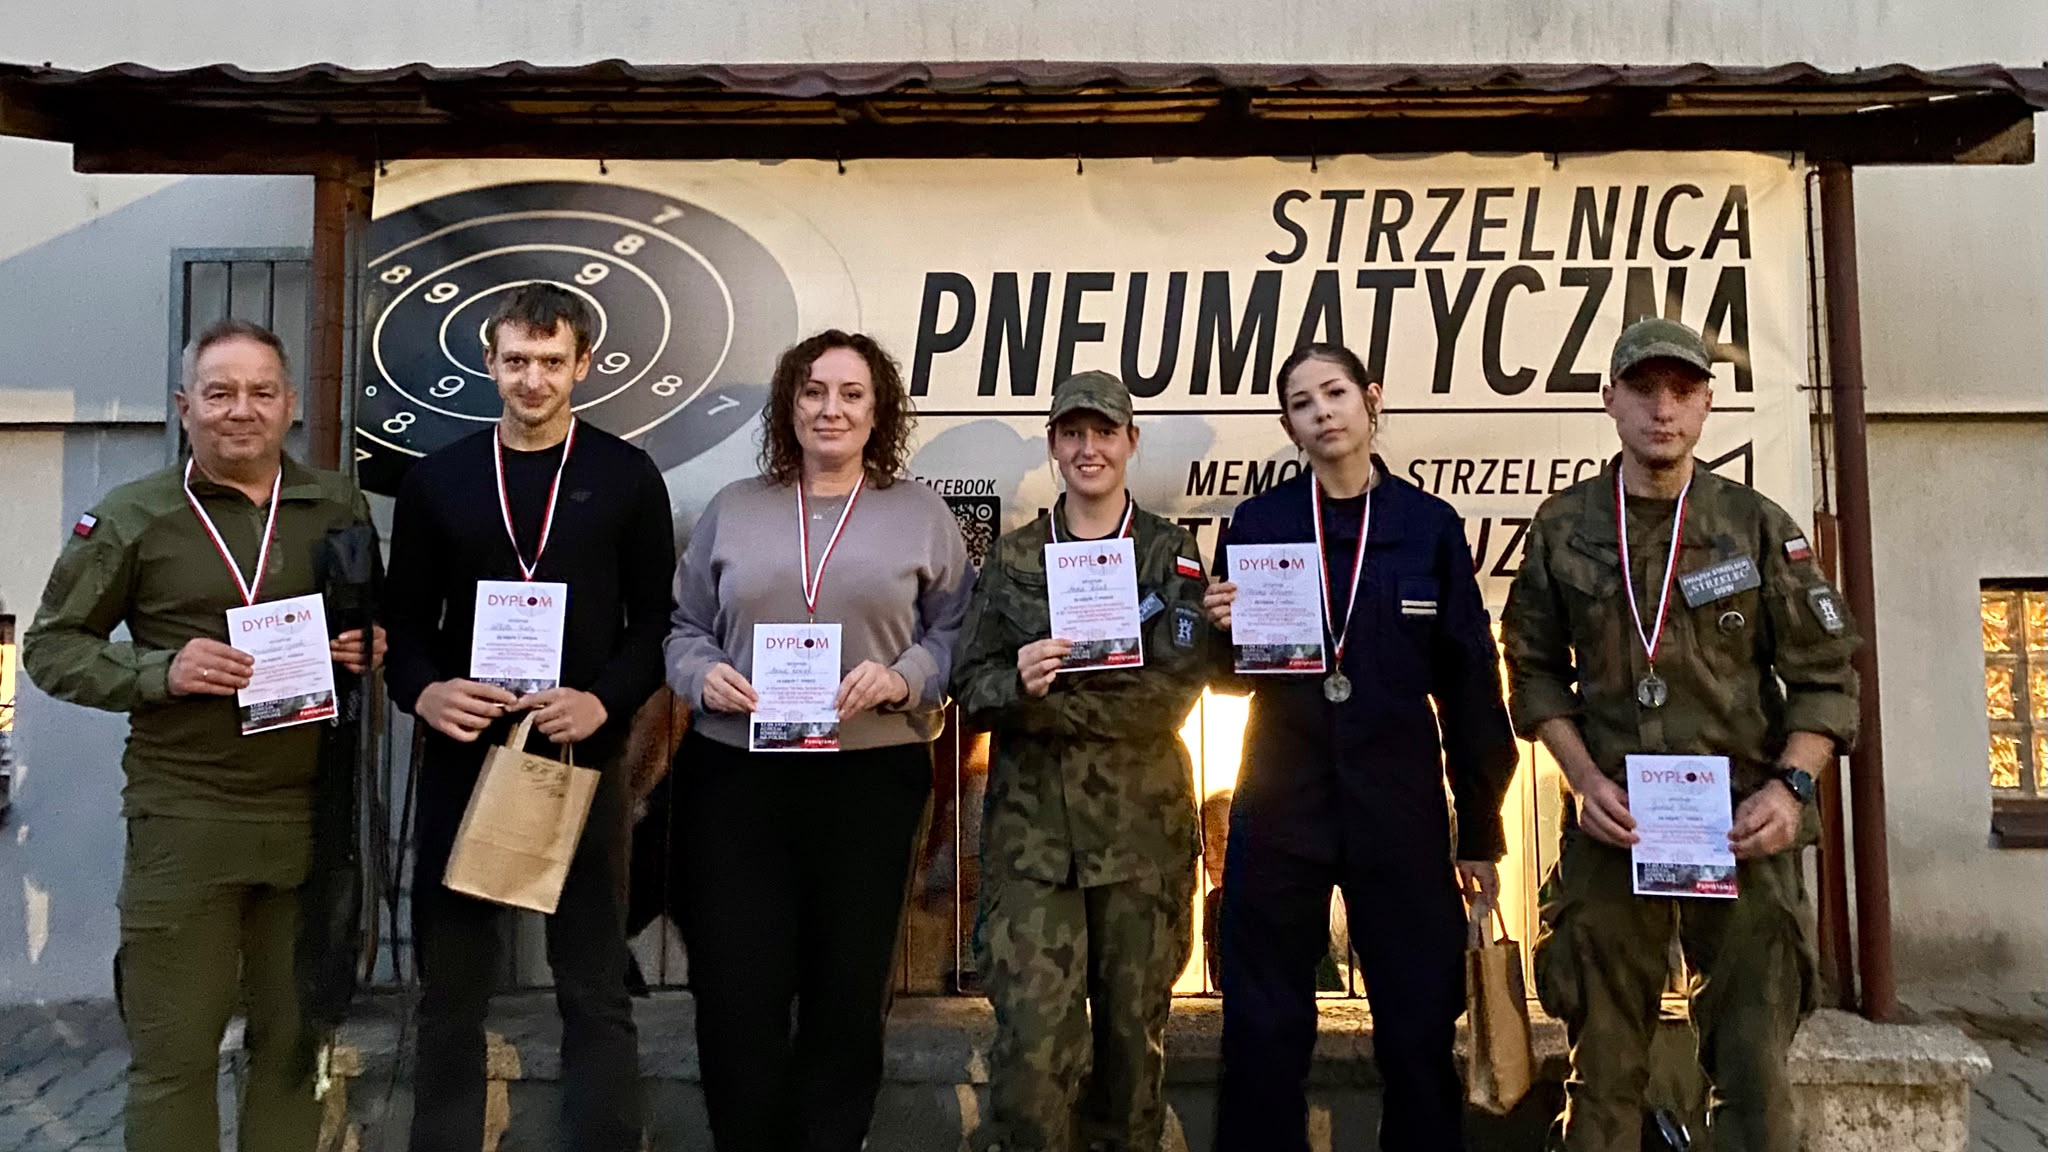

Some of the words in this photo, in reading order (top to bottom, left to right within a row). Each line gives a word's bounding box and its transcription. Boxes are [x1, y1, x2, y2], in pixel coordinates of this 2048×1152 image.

[1265, 183, 1752, 264] STRZELNICA
[613, 233, 646, 256] 8
[380, 264, 412, 285] 8
[574, 262, 611, 286] 9
[424, 281, 459, 304] 9
[597, 351, 631, 375] 9
[429, 375, 465, 398] 9
[651, 374, 684, 397] 8
[707, 394, 741, 416] 7
[382, 411, 416, 434] 8
[916, 477, 997, 495] ACEBOOK
[1186, 460, 1302, 496] MEMO
[1408, 458, 1607, 495] STRZELEC
[1058, 553, 1122, 569] DYPLOM
[1239, 558, 1305, 571] DYPLOM
[487, 594, 552, 608] DYPLOM
[242, 610, 312, 632] DYPLOM
[766, 637, 829, 649] DYPLOM
[1641, 770, 1715, 784] DYPLOM
